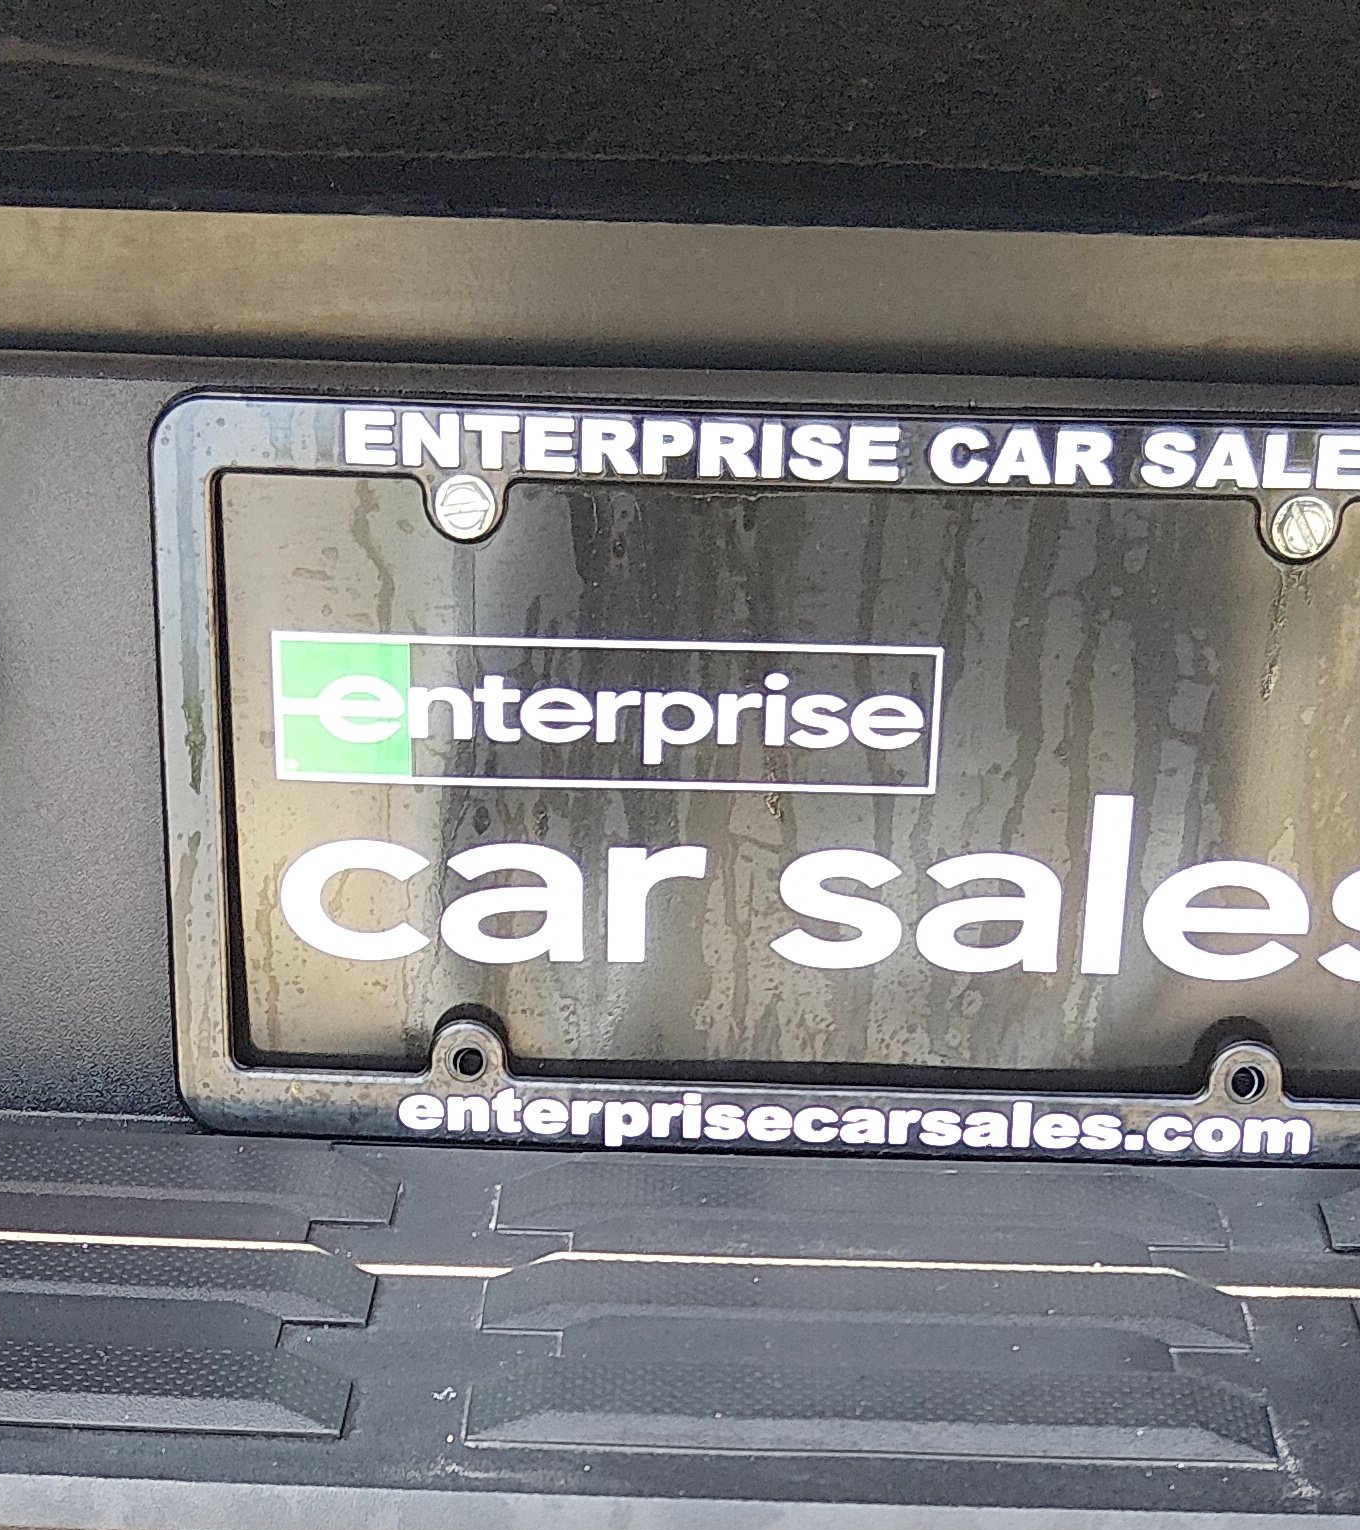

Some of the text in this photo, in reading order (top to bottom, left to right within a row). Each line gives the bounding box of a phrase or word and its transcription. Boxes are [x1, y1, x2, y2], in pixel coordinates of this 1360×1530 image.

[344, 410, 902, 482] ENTERPRISE
[930, 427, 1114, 486] CAR
[317, 672, 925, 766] enterprise
[279, 839, 709, 964] car
[397, 1087, 1313, 1156] enterprisecarsales.com
